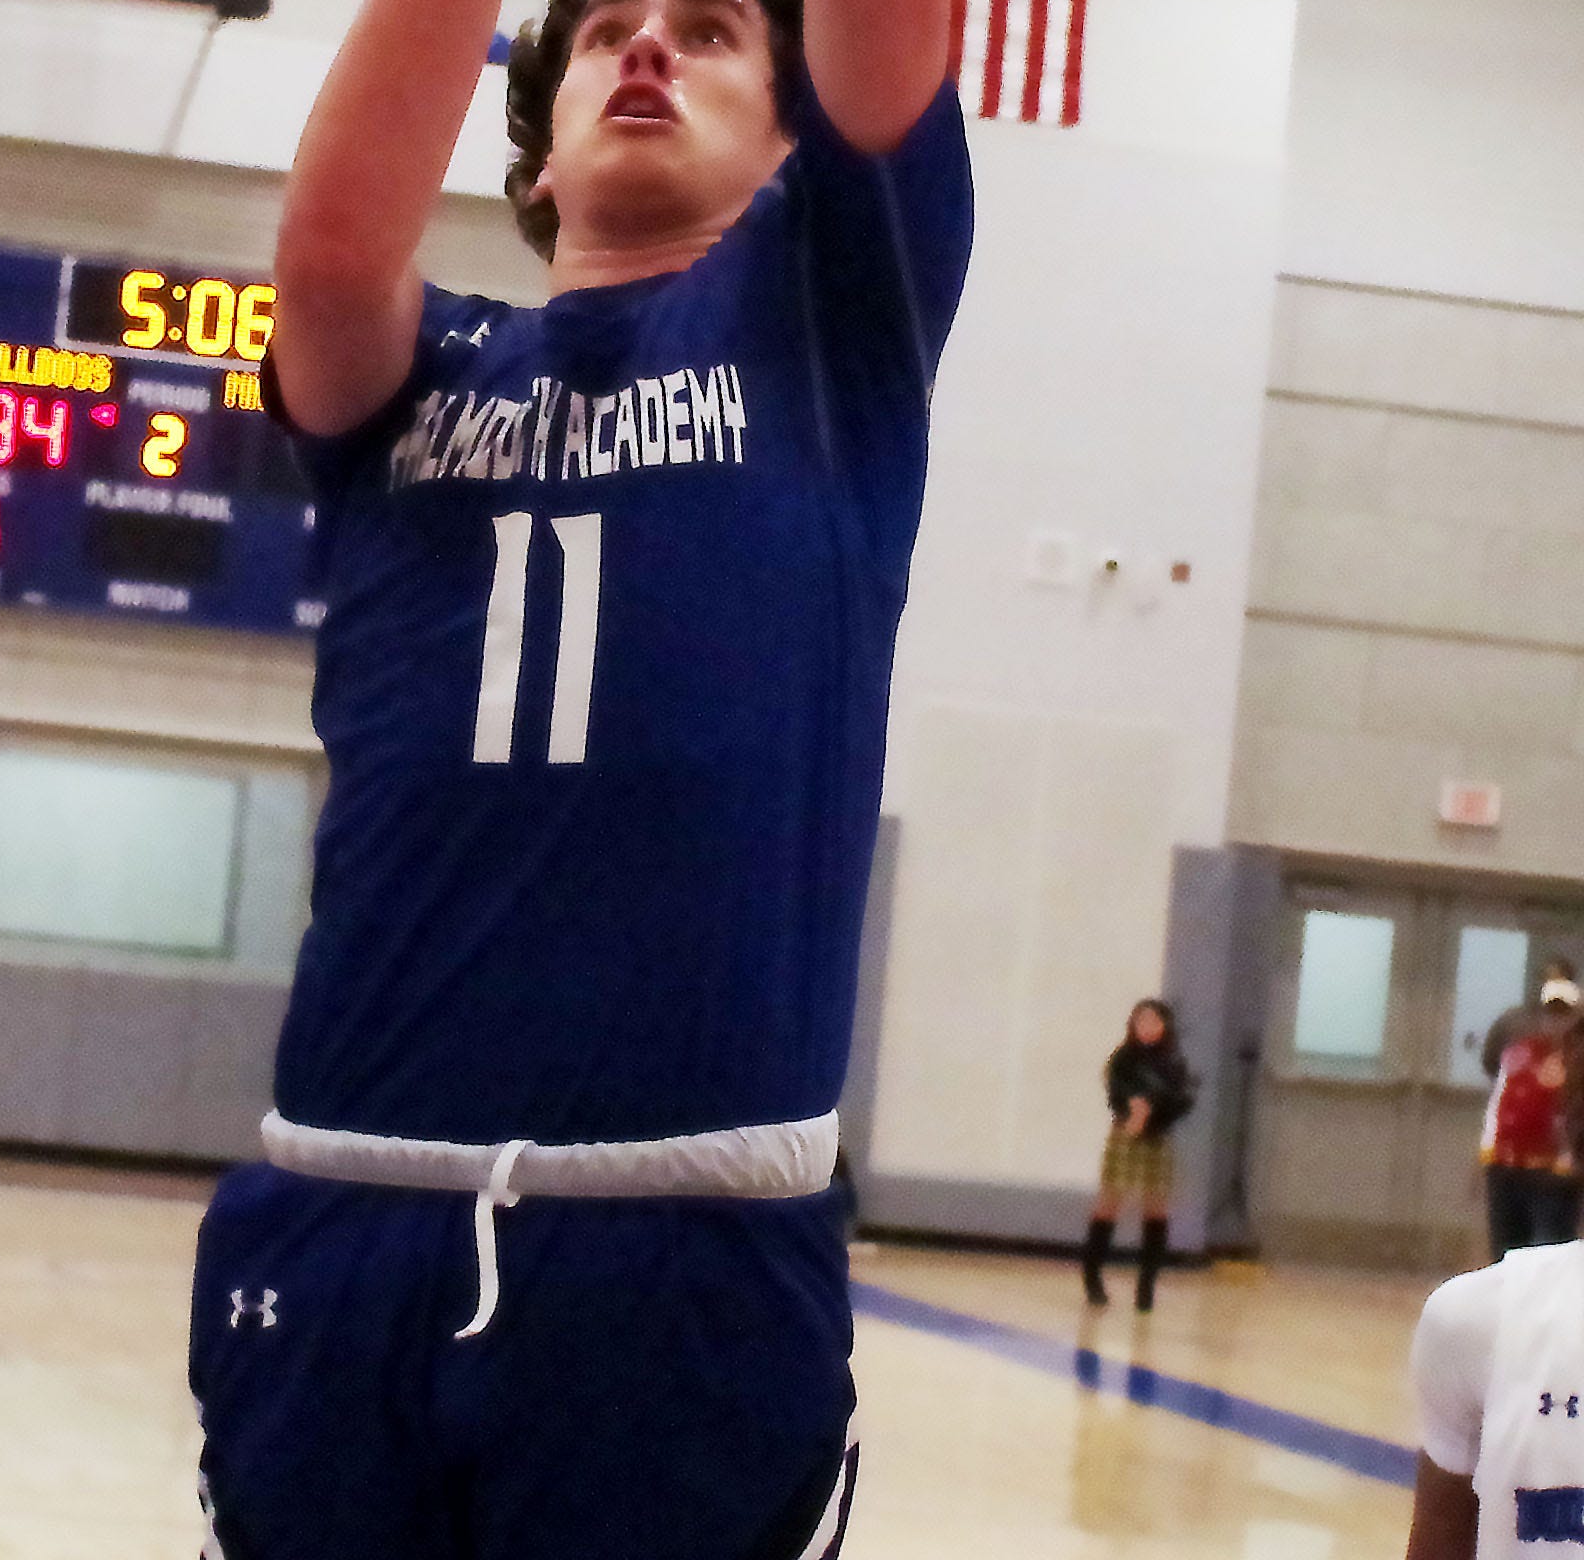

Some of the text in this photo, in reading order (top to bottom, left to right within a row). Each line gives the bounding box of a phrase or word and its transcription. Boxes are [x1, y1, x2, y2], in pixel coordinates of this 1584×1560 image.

[120, 269, 279, 361] 5:06
[141, 412, 188, 478] 2
[561, 364, 747, 481] ACADEMY
[473, 511, 602, 764] 11
